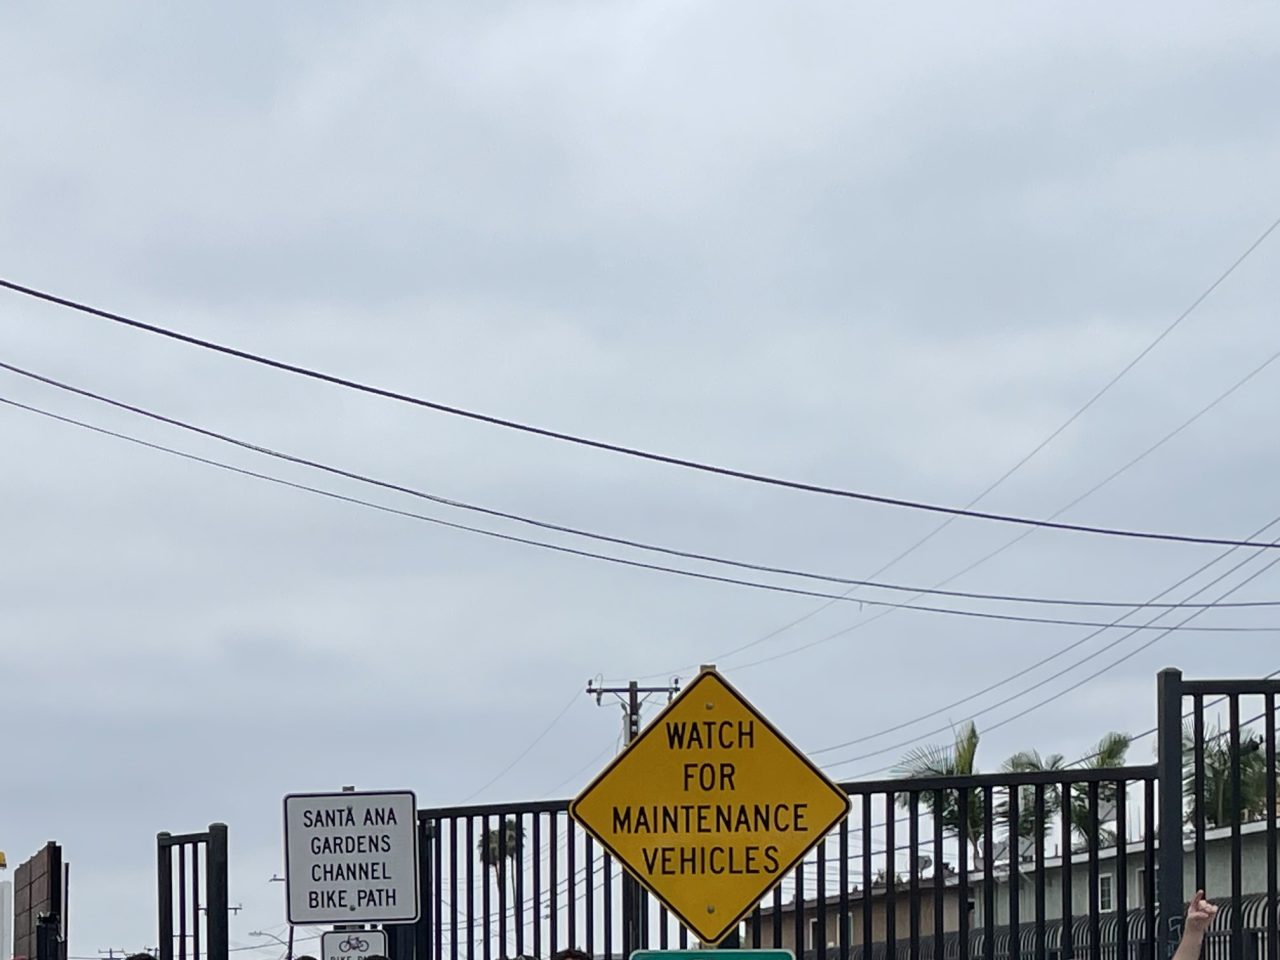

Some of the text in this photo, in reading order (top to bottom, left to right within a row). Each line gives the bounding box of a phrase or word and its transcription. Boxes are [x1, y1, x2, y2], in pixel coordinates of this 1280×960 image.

[666, 720, 755, 749] WATCH
[683, 763, 736, 792] FOR
[303, 807, 397, 828] SANTA ANA
[612, 803, 809, 834] MAINTENANCE
[311, 834, 391, 855] GARDENS
[311, 862, 392, 882] CHANNEL
[642, 845, 780, 876] VEHICLES
[309, 888, 396, 909] BIKE PATH
